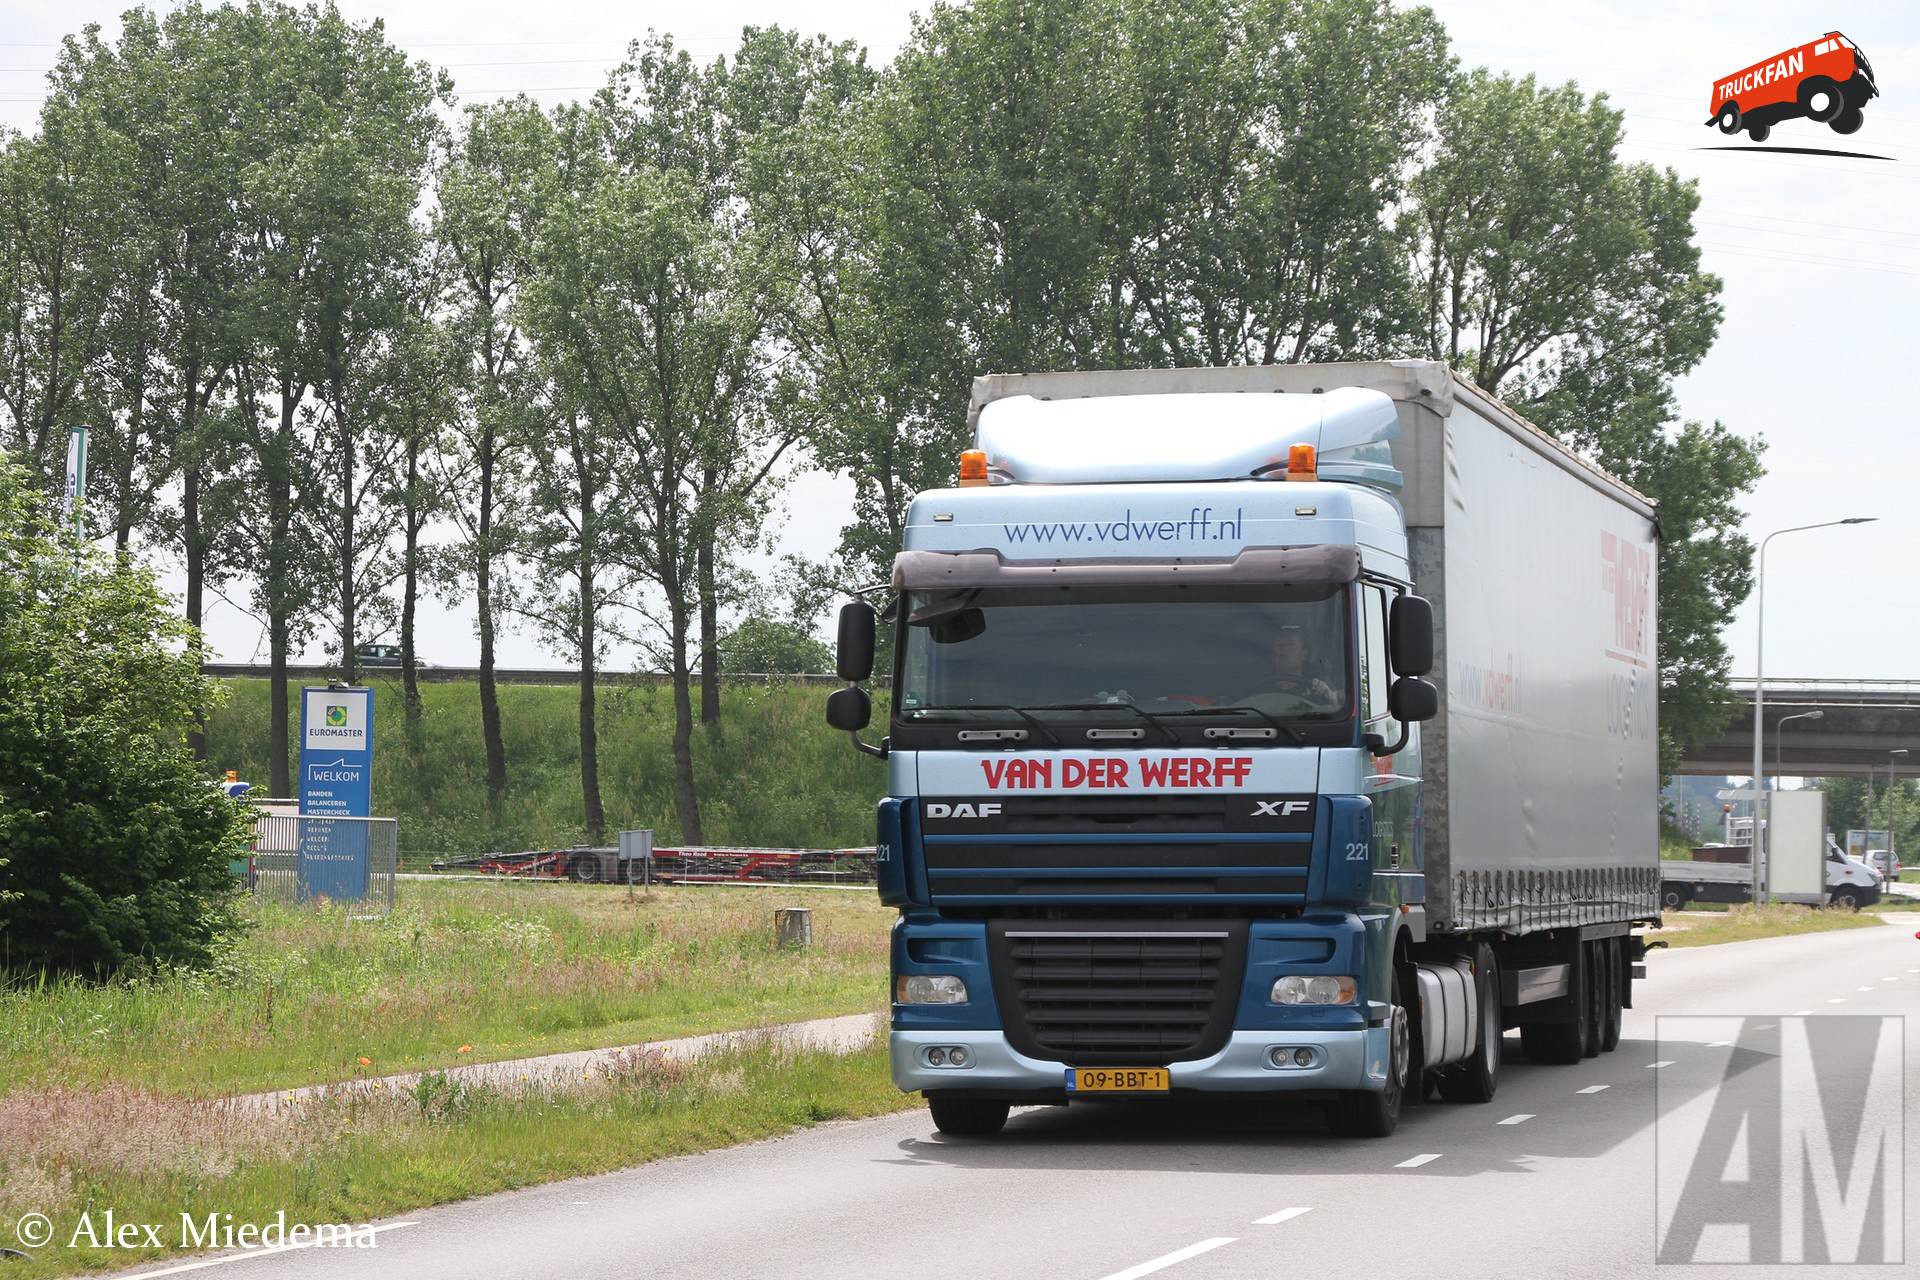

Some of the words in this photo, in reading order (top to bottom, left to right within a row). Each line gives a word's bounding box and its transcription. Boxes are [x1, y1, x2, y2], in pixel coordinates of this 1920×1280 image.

[1003, 508, 1242, 544] www.vdwerff.nl
[309, 728, 363, 737] EUROMASTER
[313, 770, 360, 782] WELKOM
[981, 758, 1052, 789] VAN
[1061, 758, 1129, 788] DER
[1138, 757, 1253, 788] WERFF
[307, 790, 333, 798] BANDEN
[927, 803, 1002, 818] DAF
[1250, 801, 1310, 816] XF
[1345, 842, 1369, 861] 221
[1083, 1072, 1160, 1088] 09-BBT-1
